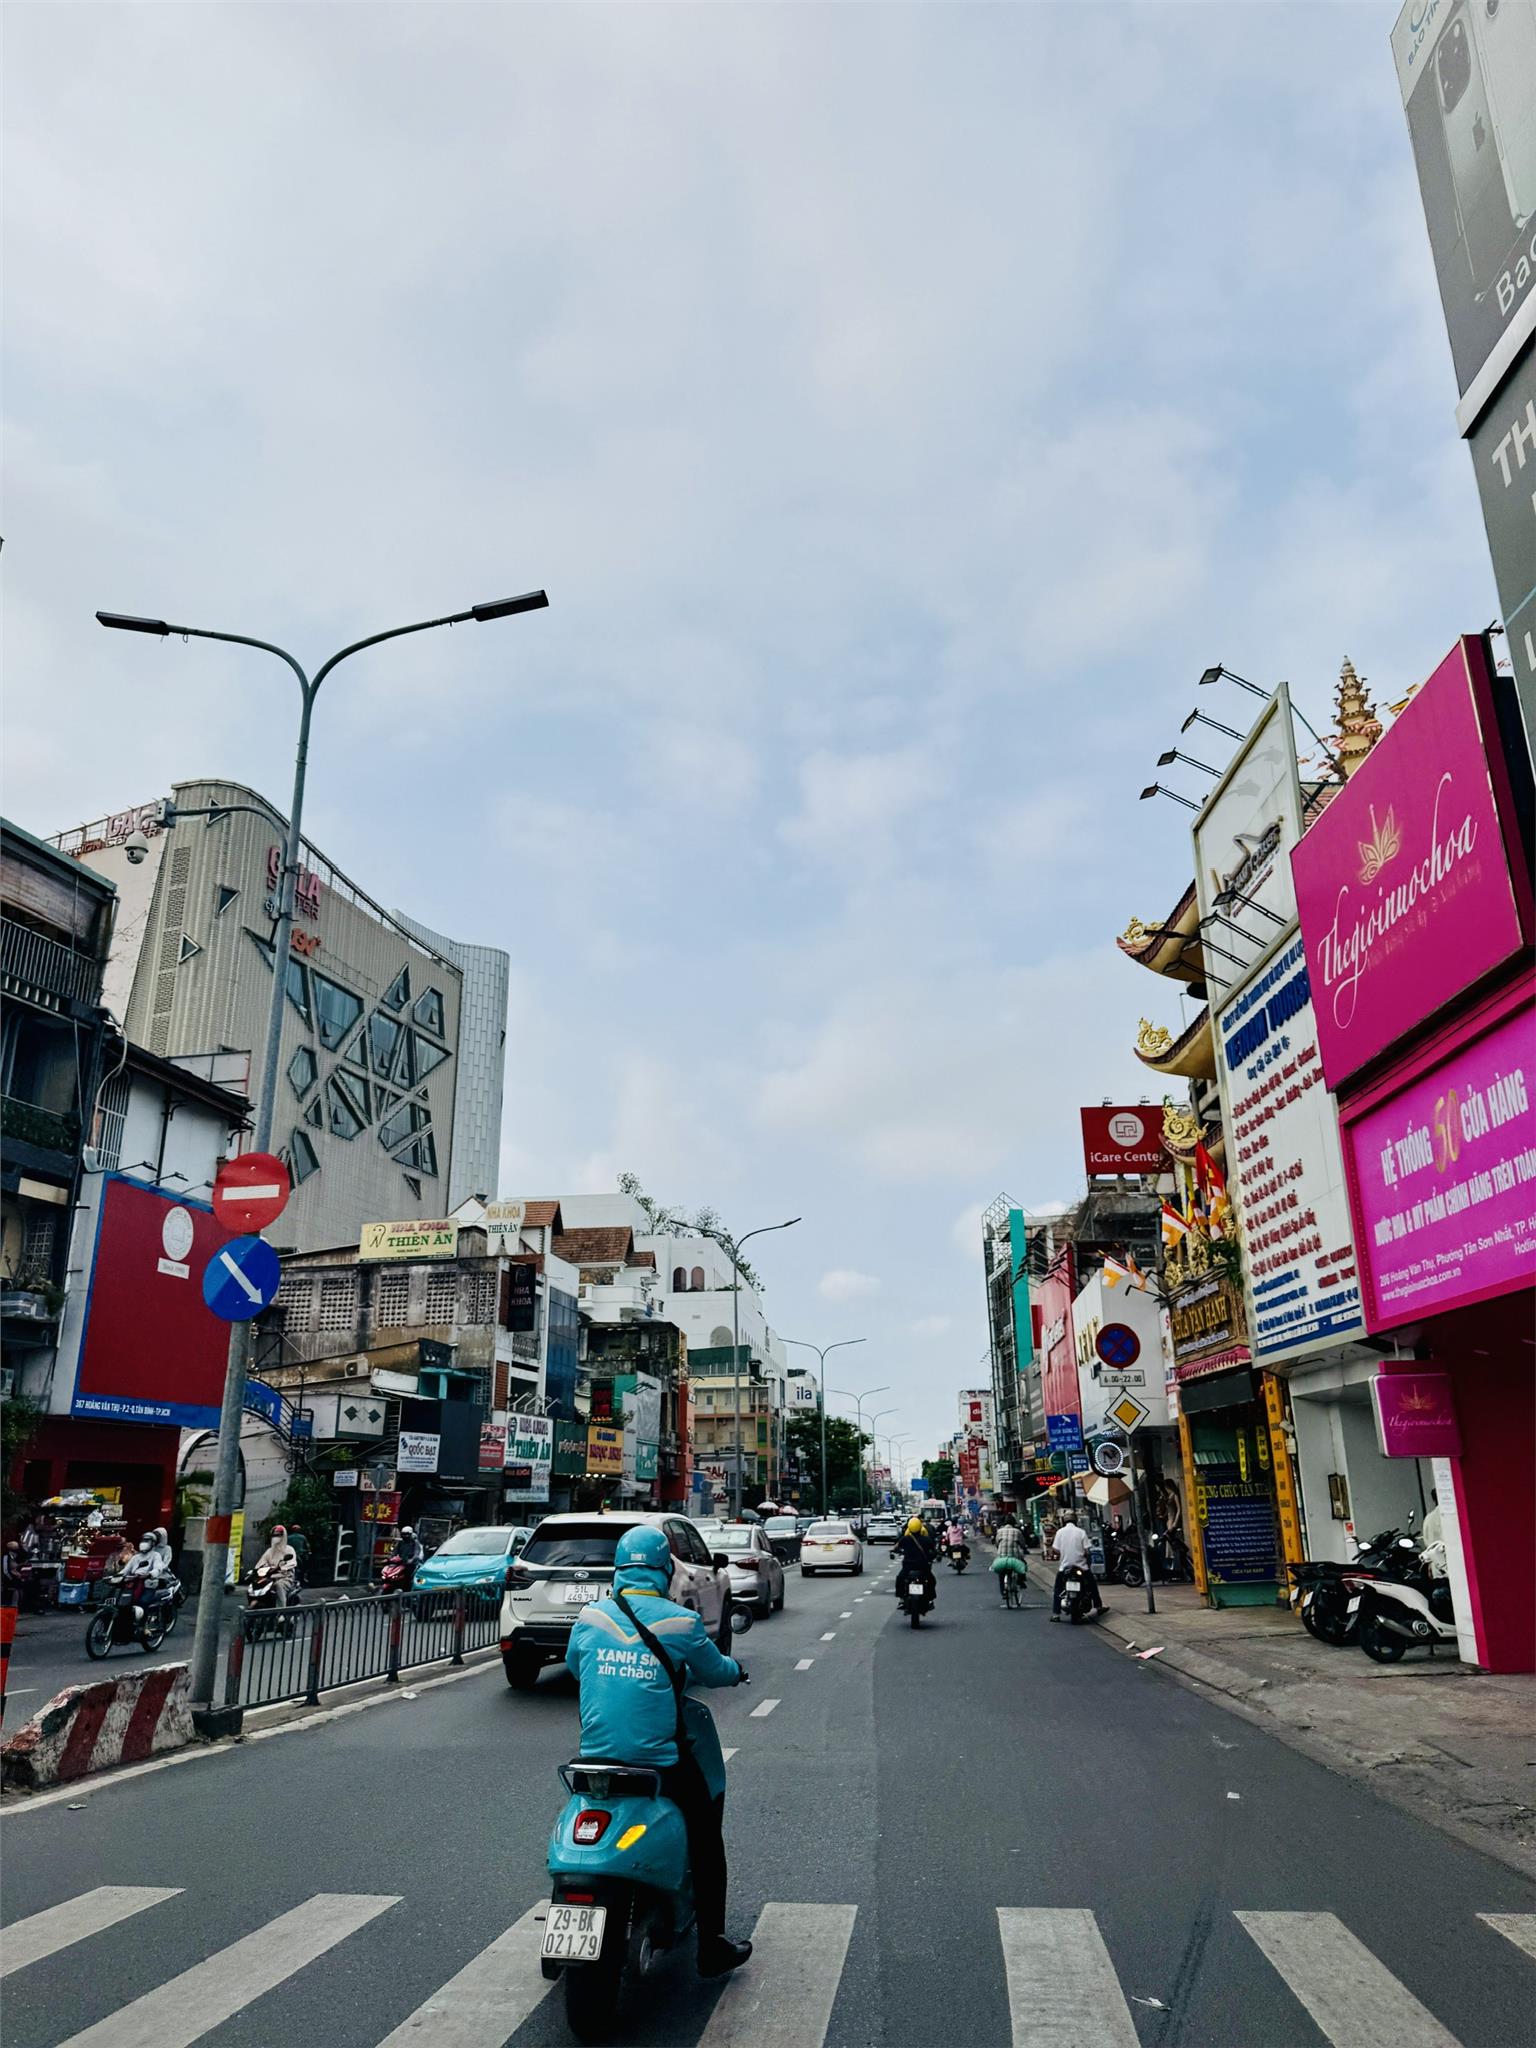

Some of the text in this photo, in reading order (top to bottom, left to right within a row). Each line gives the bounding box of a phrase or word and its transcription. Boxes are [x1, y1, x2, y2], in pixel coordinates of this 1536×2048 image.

[1381, 1138, 1398, 1190] HỆ
[1395, 1120, 1434, 1178] THỐNG
[1460, 1084, 1490, 1143] CỬA
[1487, 1068, 1529, 1129] HÀNG
[1090, 1151, 1122, 1163] iCare
[1491, 1157, 1517, 1195] TRÊN
[391, 1223, 416, 1233] NHA
[387, 1232, 431, 1248] THIÊN
[796, 1386, 812, 1400] ila
[574, 1583, 589, 1594] 51L
[567, 1593, 595, 1602] 449.79
[596, 1647, 637, 1663] XANH
[597, 1663, 657, 1681] xin chào!
[553, 1909, 597, 1932] 29-BK
[545, 1933, 598, 1957] 021.79
